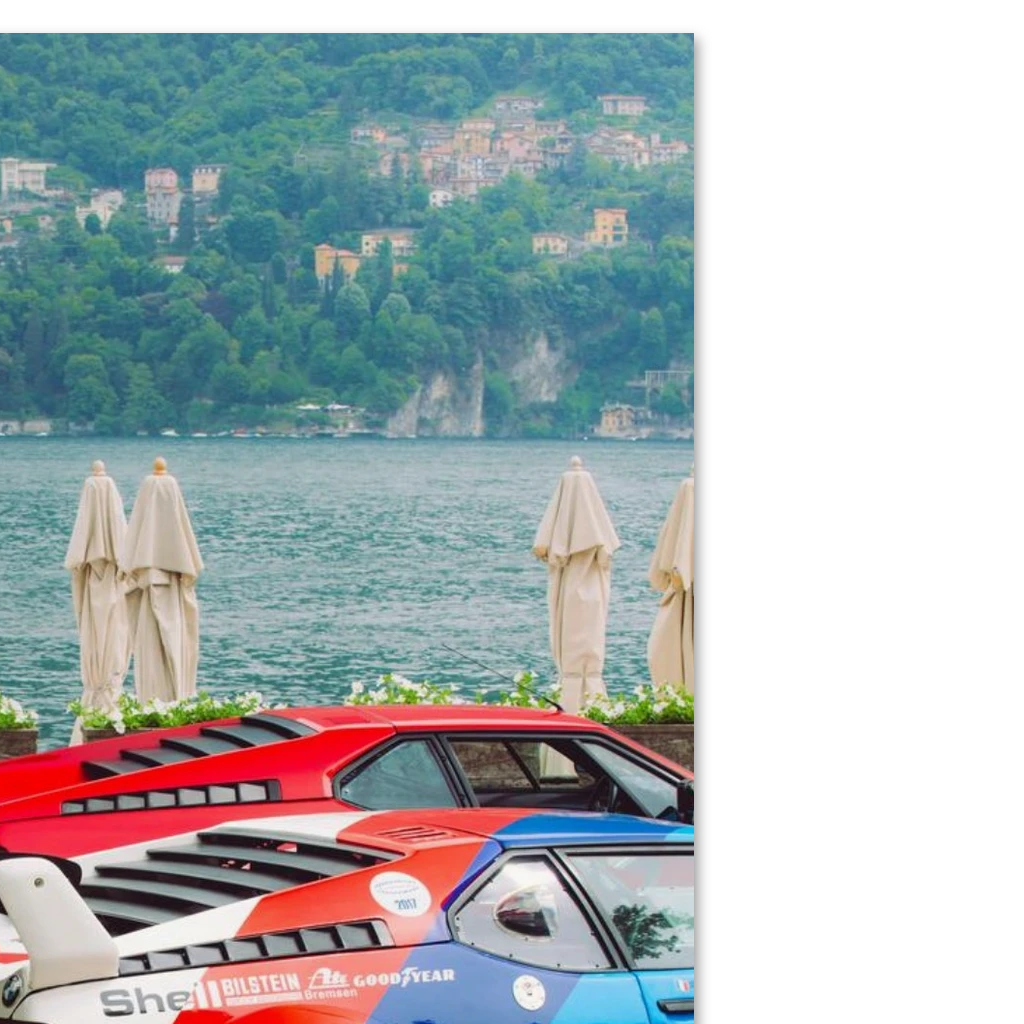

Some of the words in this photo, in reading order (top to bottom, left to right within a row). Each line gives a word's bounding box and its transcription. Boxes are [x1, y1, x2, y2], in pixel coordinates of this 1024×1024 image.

[222, 973, 301, 996] BILSTEIN
[353, 966, 455, 988] GOODYEAR
[100, 981, 223, 1017] Shell
[304, 988, 358, 1000] Bremsen
